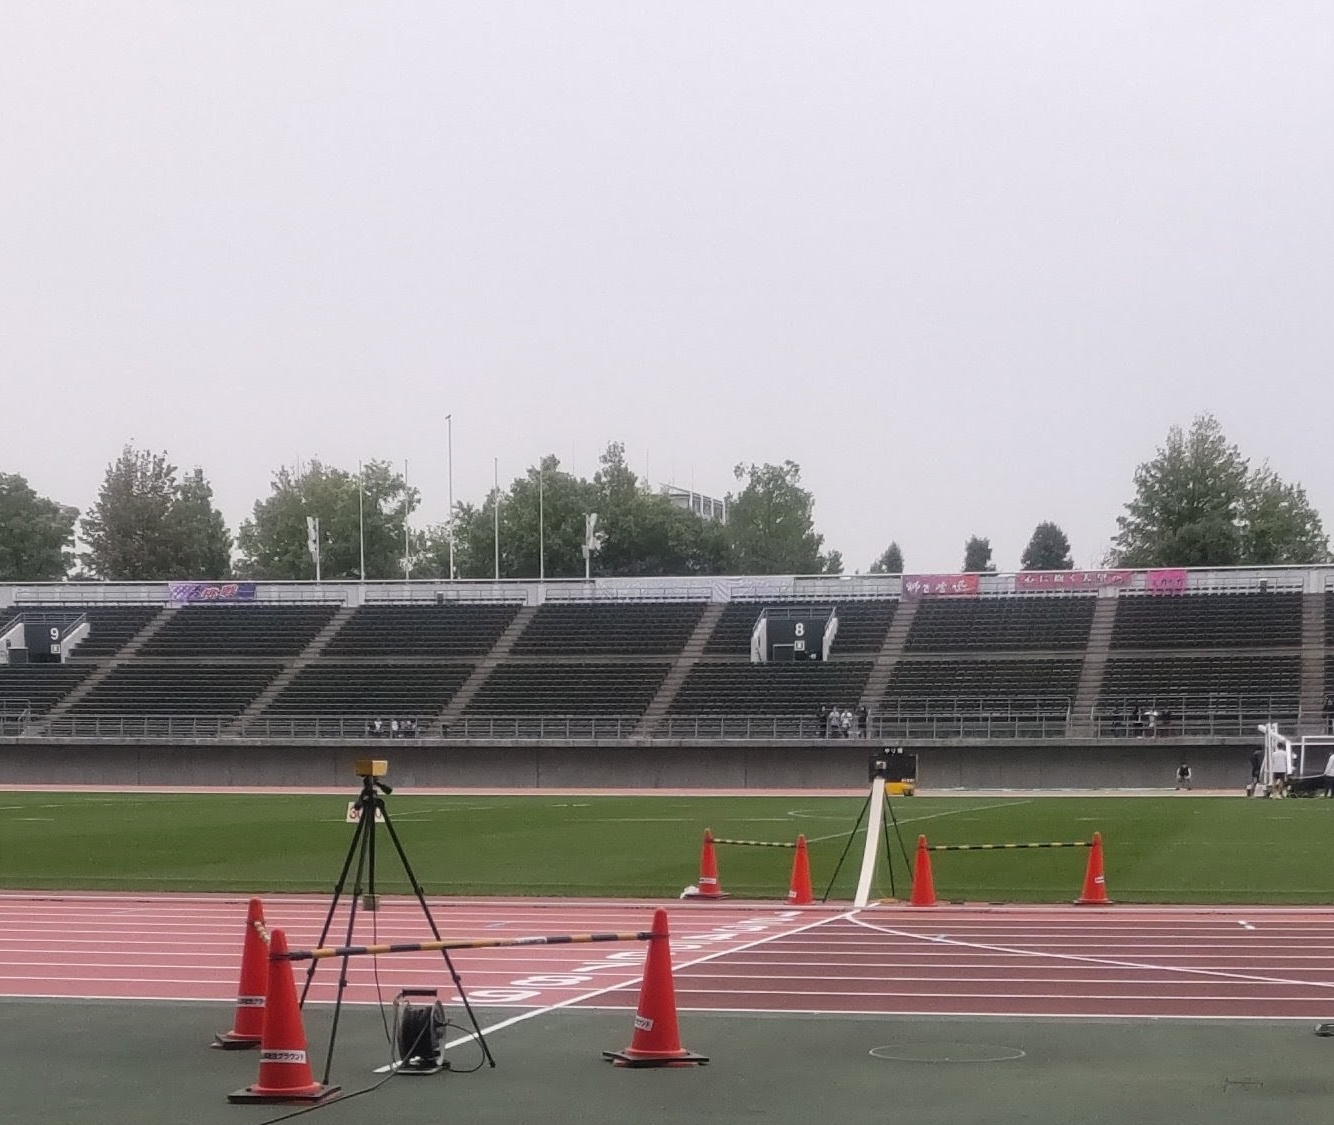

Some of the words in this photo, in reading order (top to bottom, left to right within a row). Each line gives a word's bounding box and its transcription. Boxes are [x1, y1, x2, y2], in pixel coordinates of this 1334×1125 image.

[50, 627, 59, 640] 9
[794, 623, 805, 636] 8
[510, 975, 593, 986] 8
[450, 990, 542, 1003] 9
